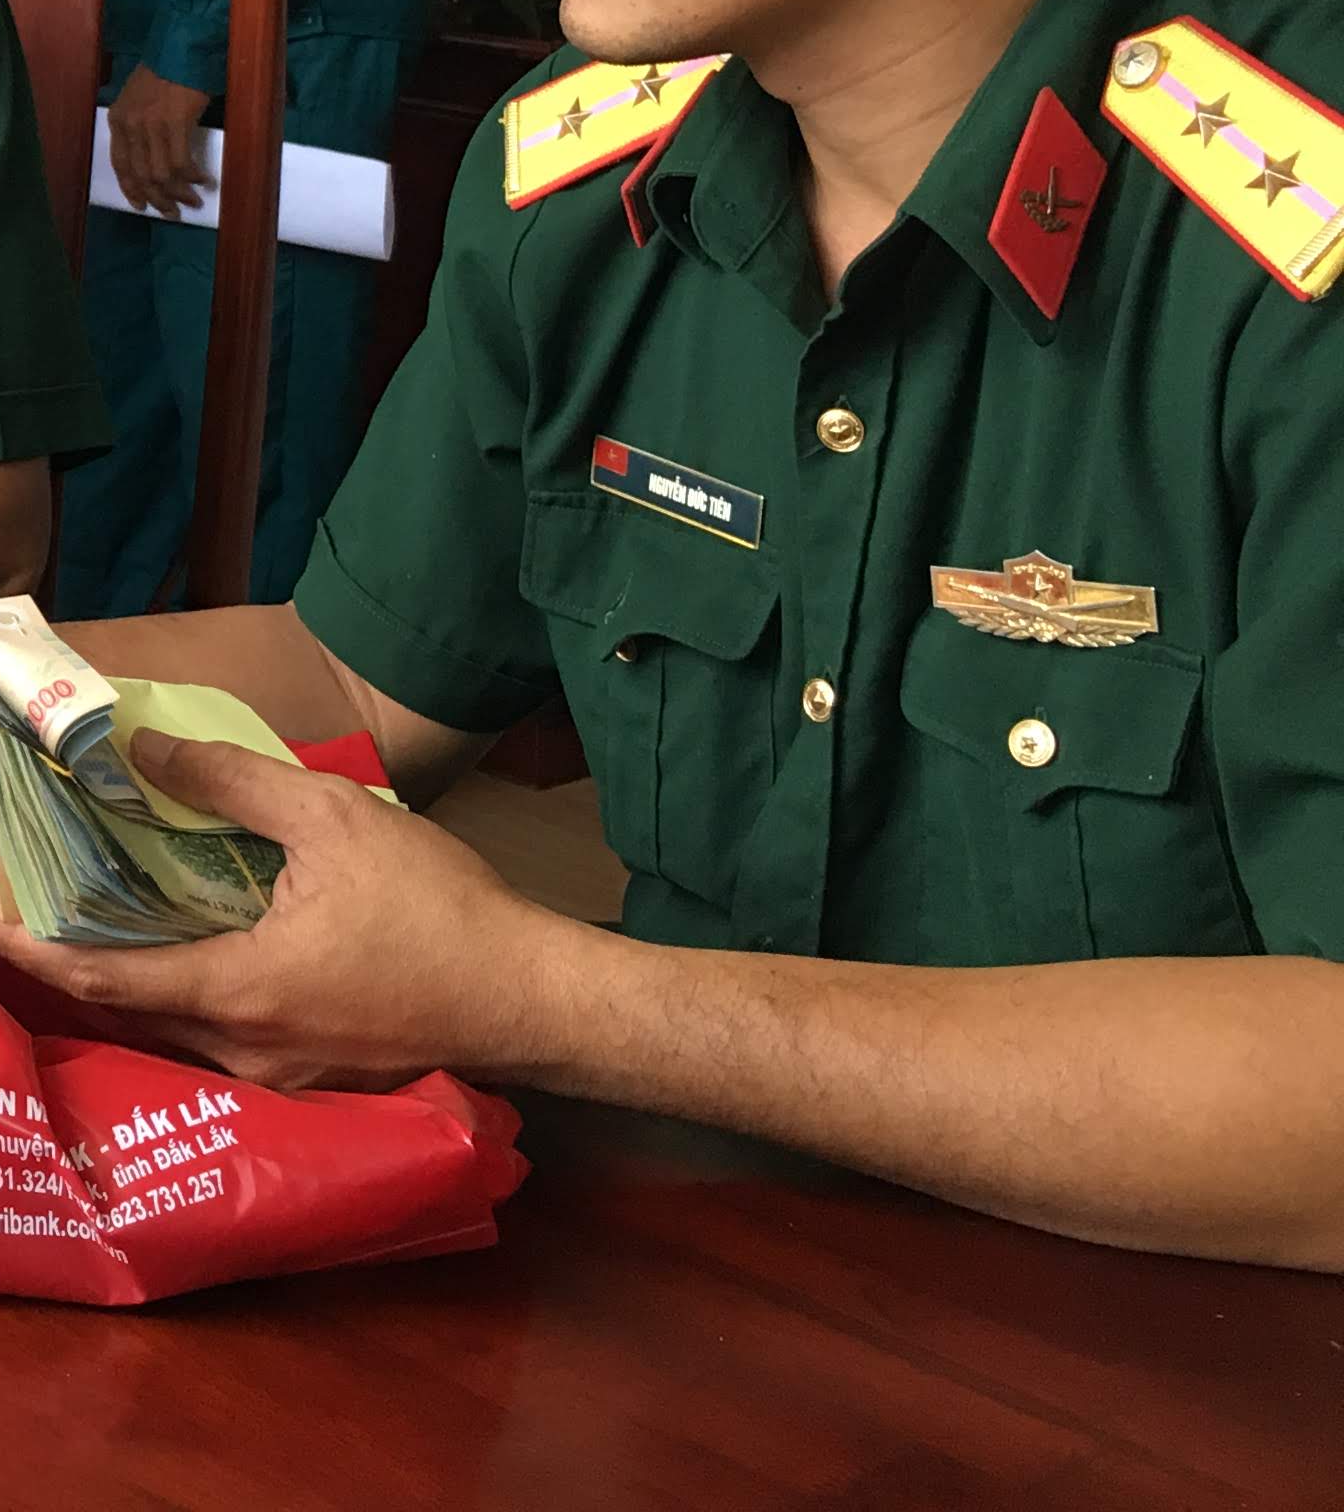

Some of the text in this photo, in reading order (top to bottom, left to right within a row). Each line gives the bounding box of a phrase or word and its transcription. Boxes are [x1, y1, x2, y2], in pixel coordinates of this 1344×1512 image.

[112, 1105, 177, 1151] ĐẮK
[177, 1088, 242, 1128] LẮK
[112, 1155, 154, 1190] tỉnh
[151, 1137, 198, 1171] Đắk
[195, 1124, 240, 1156] Lắk
